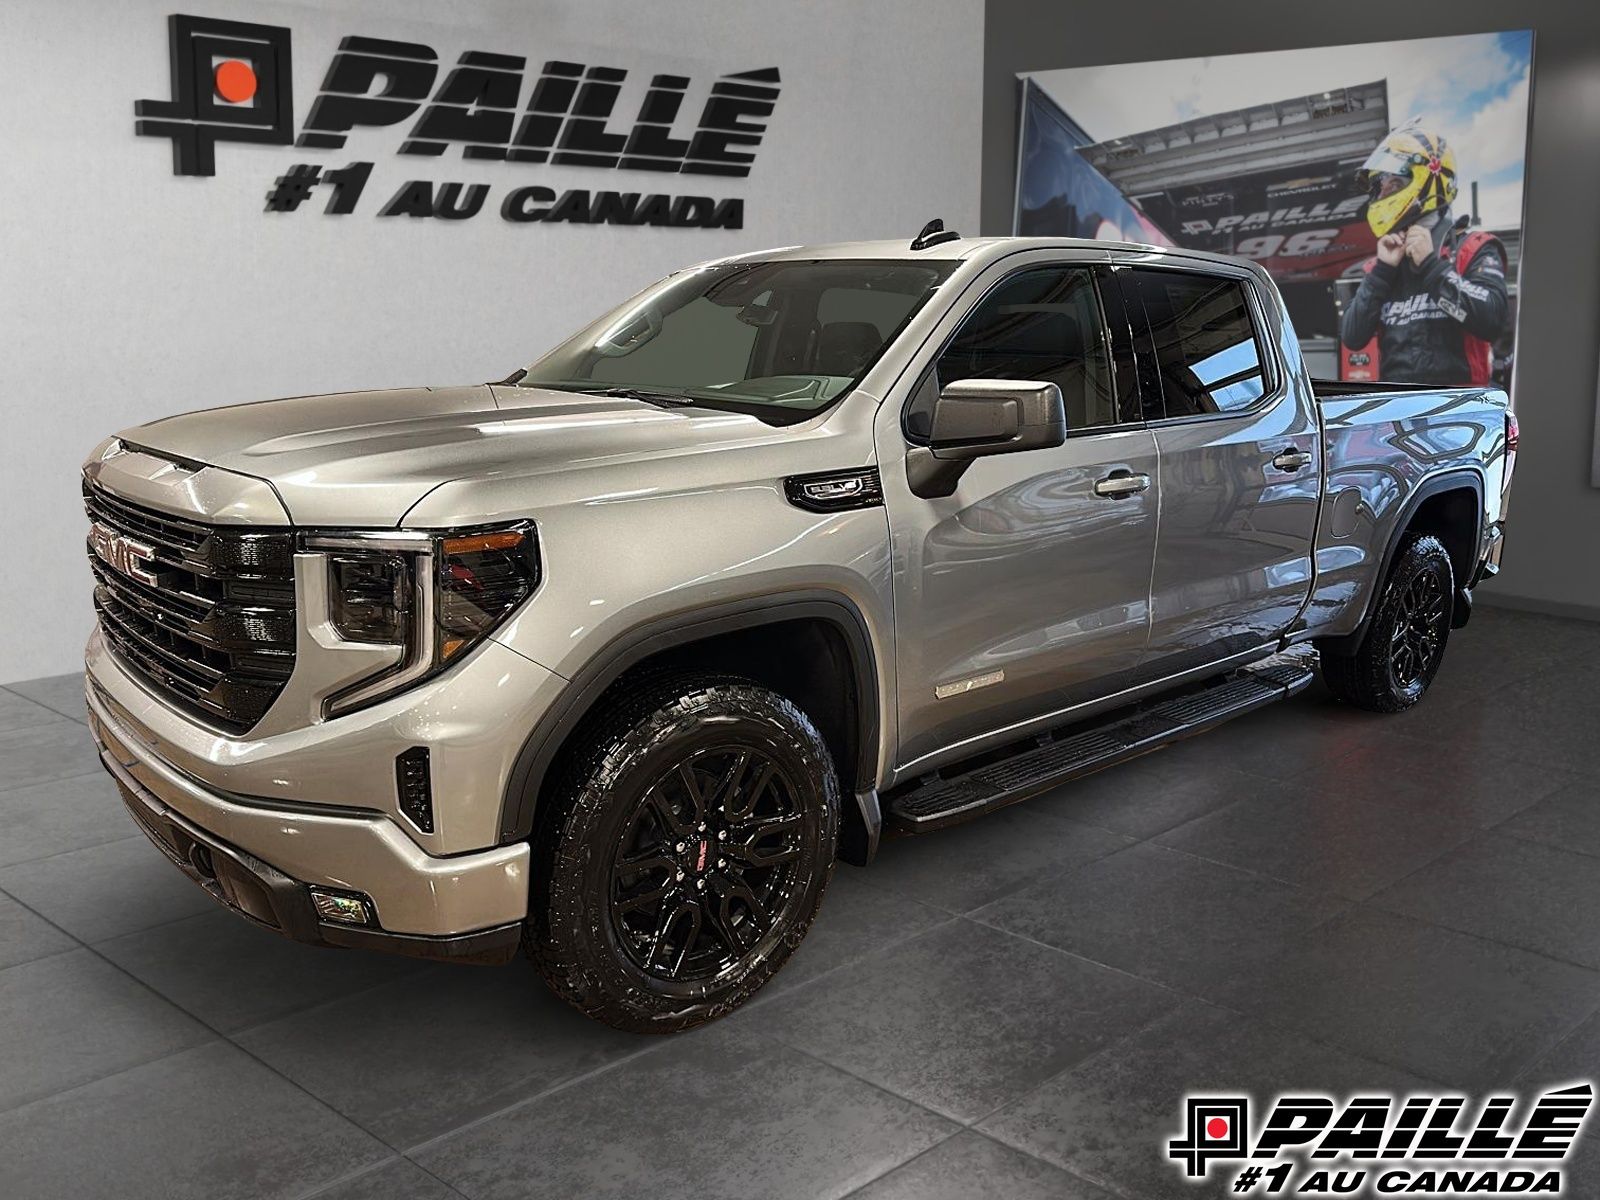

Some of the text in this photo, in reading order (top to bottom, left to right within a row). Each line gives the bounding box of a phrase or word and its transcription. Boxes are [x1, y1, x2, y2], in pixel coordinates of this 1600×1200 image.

[294, 36, 782, 178] PAILLÉ
[262, 162, 745, 230] #1 AU CANADA
[1235, 228, 1340, 260] 96
[87, 522, 158, 588] GMC
